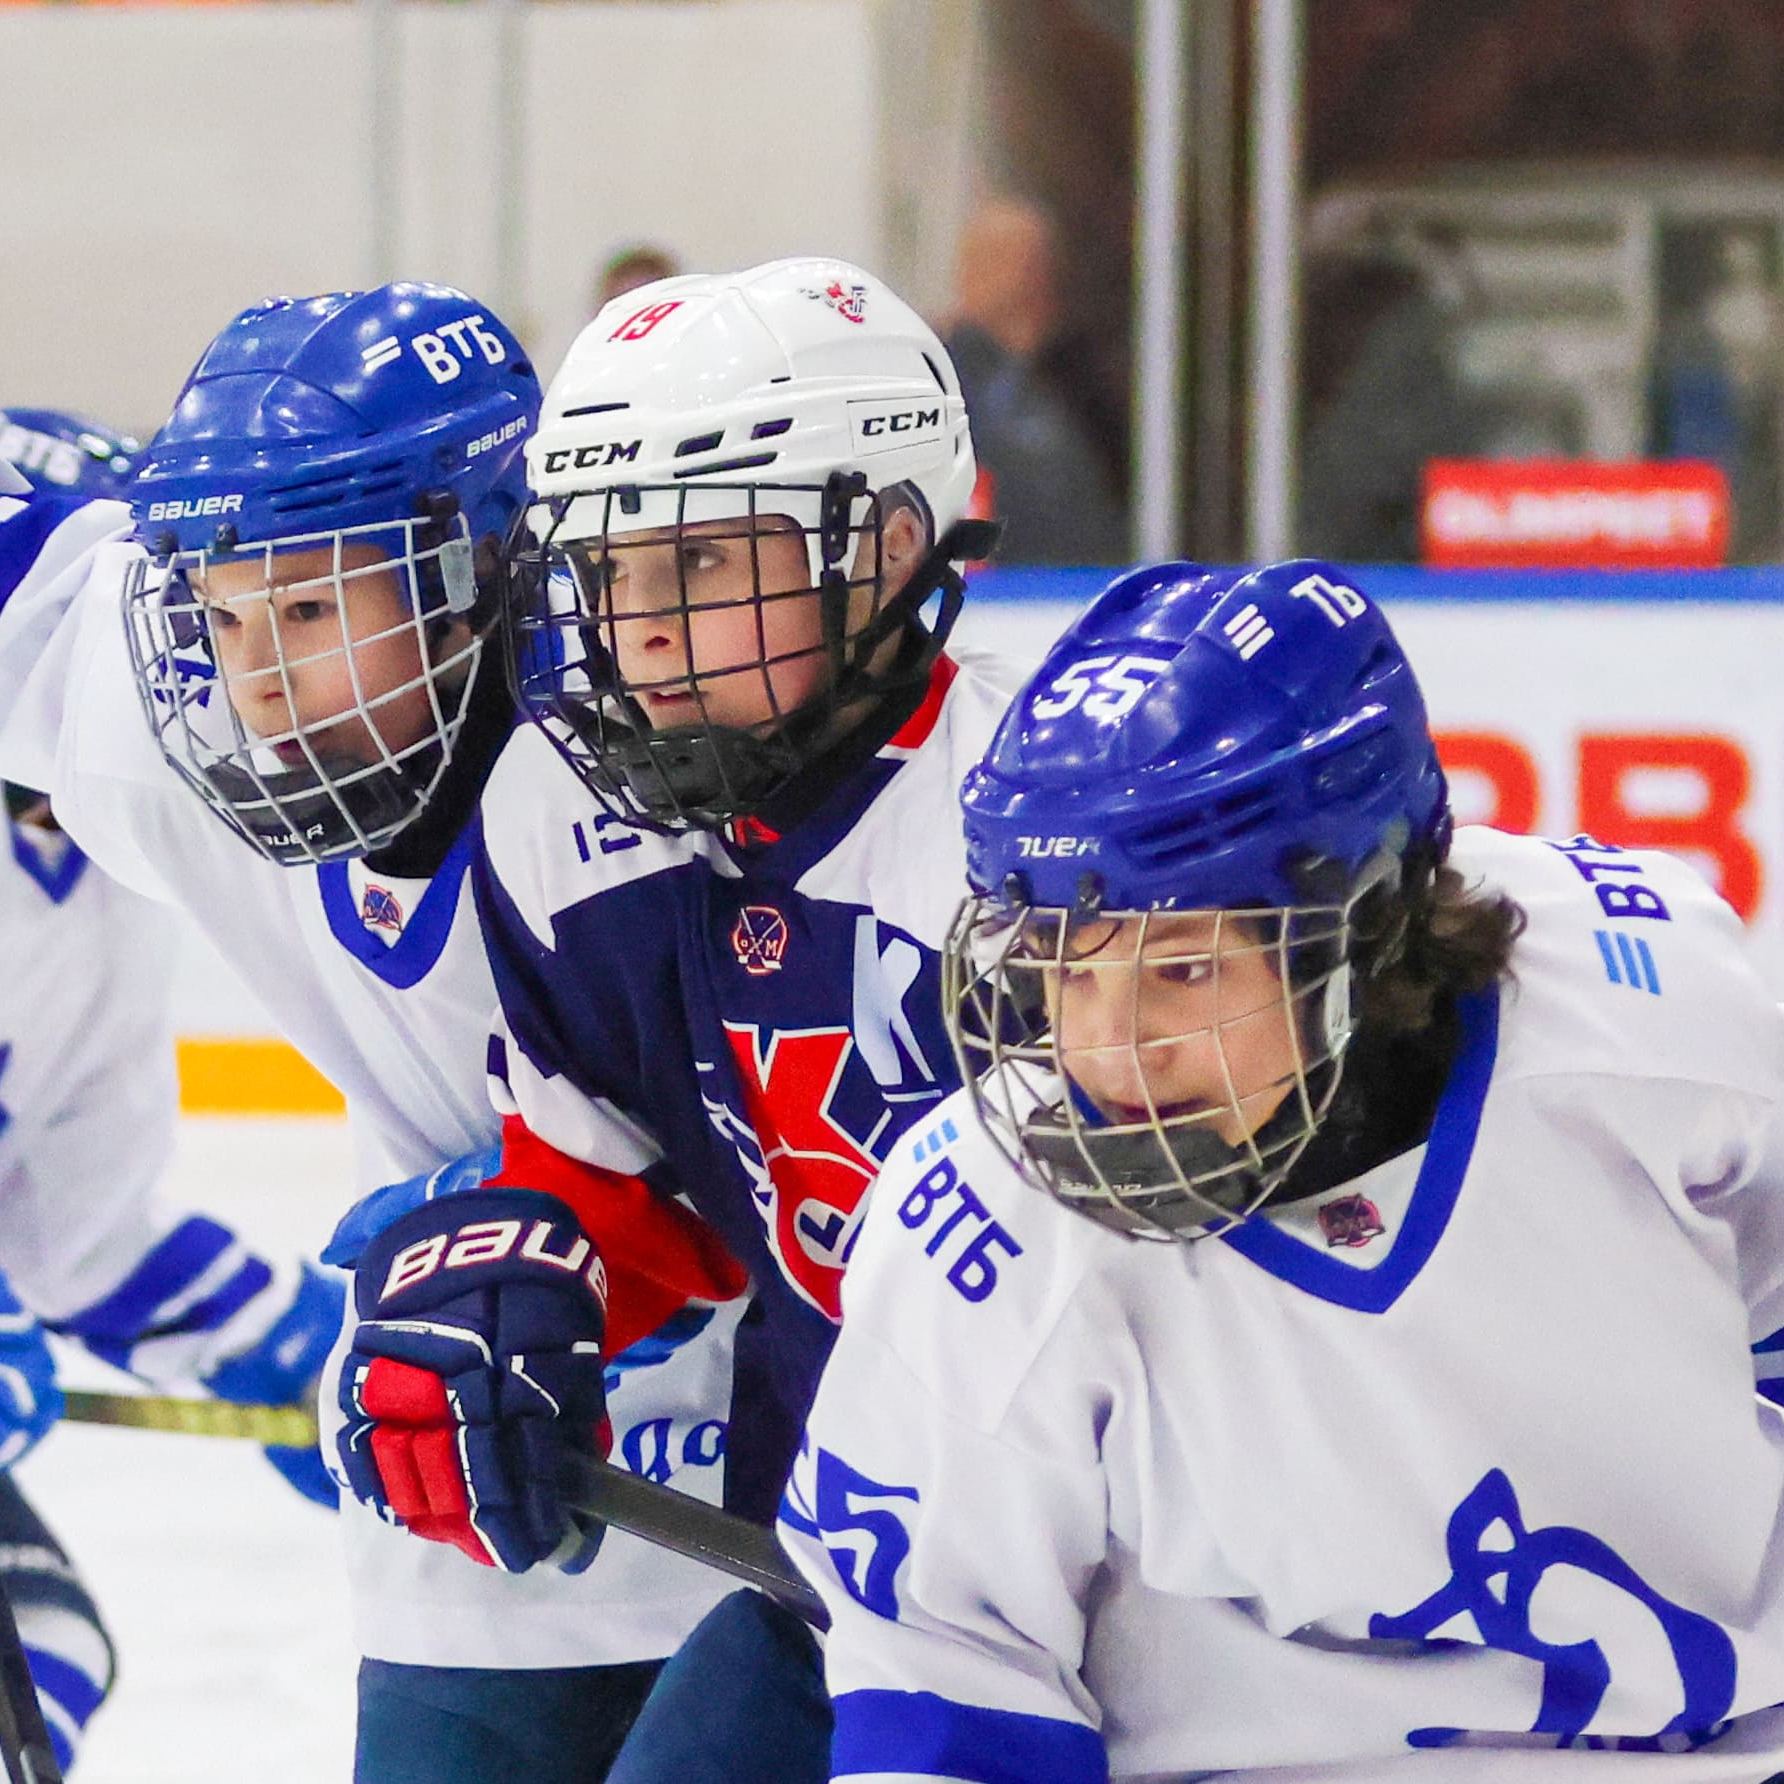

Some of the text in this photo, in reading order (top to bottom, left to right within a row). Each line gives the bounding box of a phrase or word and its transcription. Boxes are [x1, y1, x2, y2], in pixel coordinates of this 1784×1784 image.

[607, 301, 685, 342] 19
[466, 415, 528, 459] BAUER
[862, 408, 940, 437] CCM
[544, 440, 642, 474] CCM
[147, 493, 244, 521] BAUER
[1032, 655, 1171, 722] 55
[897, 1155, 1024, 1304] ВТБ
[377, 1218, 608, 1312] BAUE
